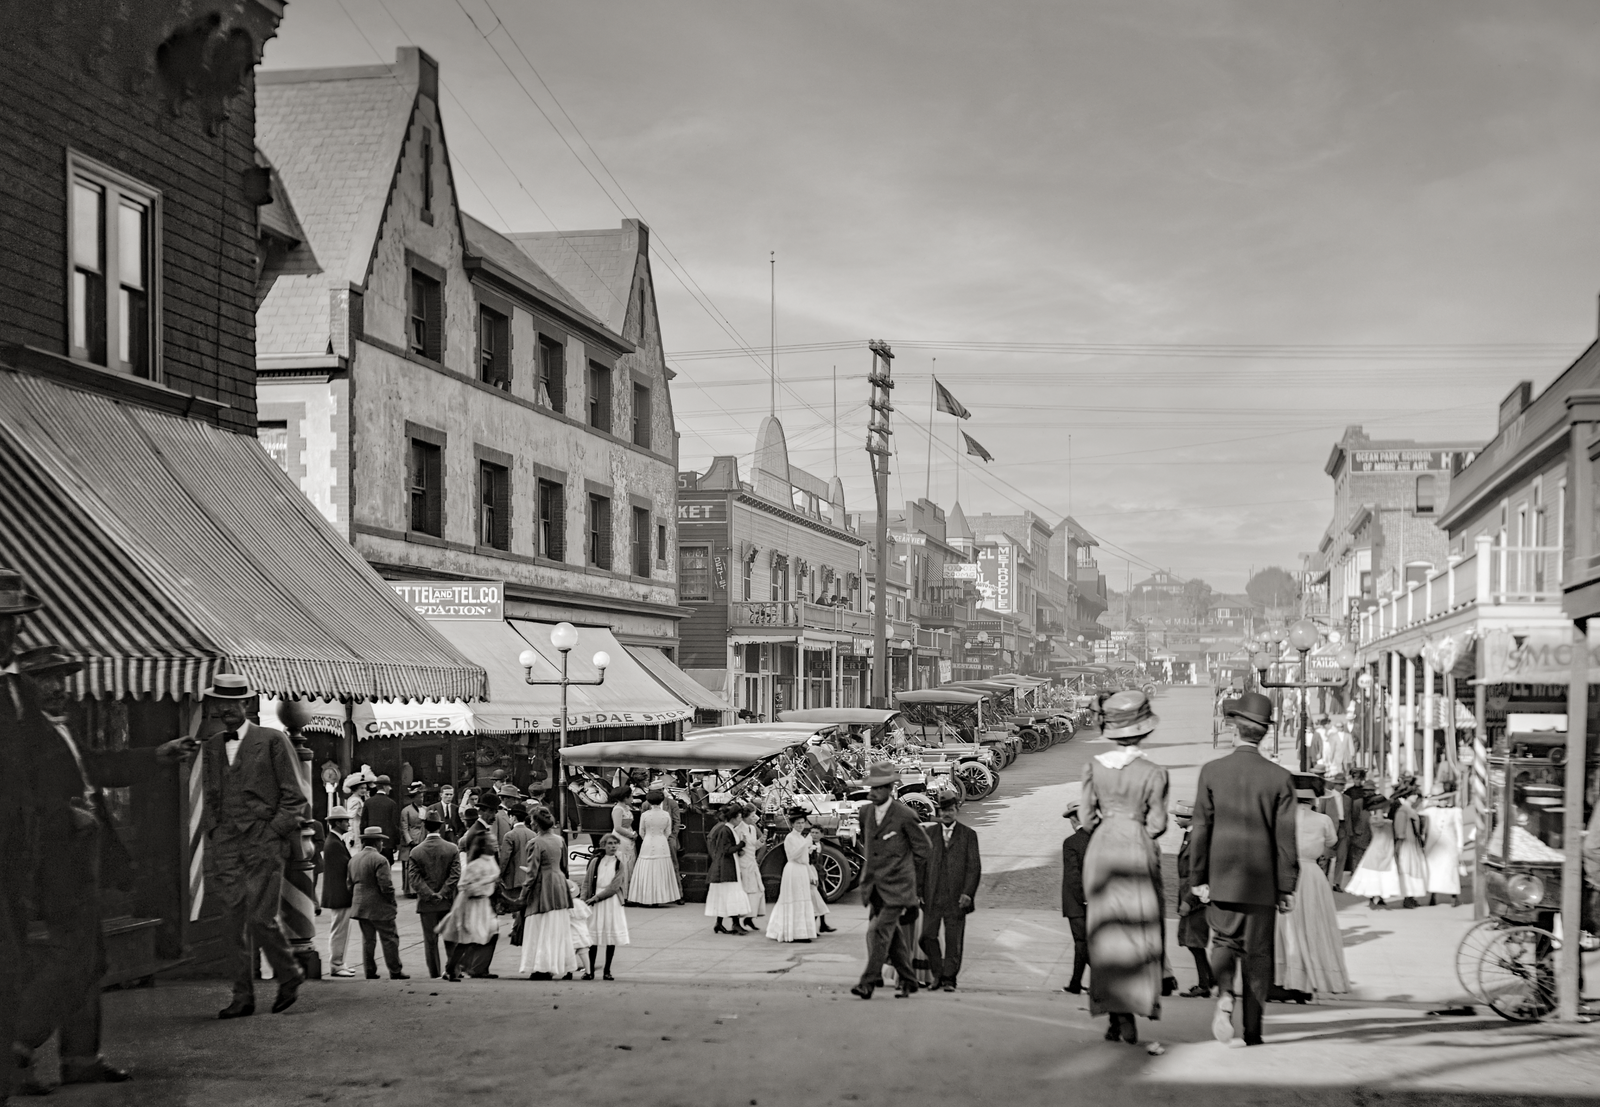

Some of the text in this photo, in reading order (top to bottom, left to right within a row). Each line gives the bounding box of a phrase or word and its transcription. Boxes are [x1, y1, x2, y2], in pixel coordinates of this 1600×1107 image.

[1355, 451, 1379, 462] OCEAN
[1380, 451, 1400, 462] PARK
[1401, 451, 1433, 462] SCHOOL
[997, 546, 1009, 609] METROPOLE
[815, 661, 863, 669] GRERY
[365, 717, 451, 734] CANDIES
[512, 709, 686, 729] The SUNDAE SHOP
